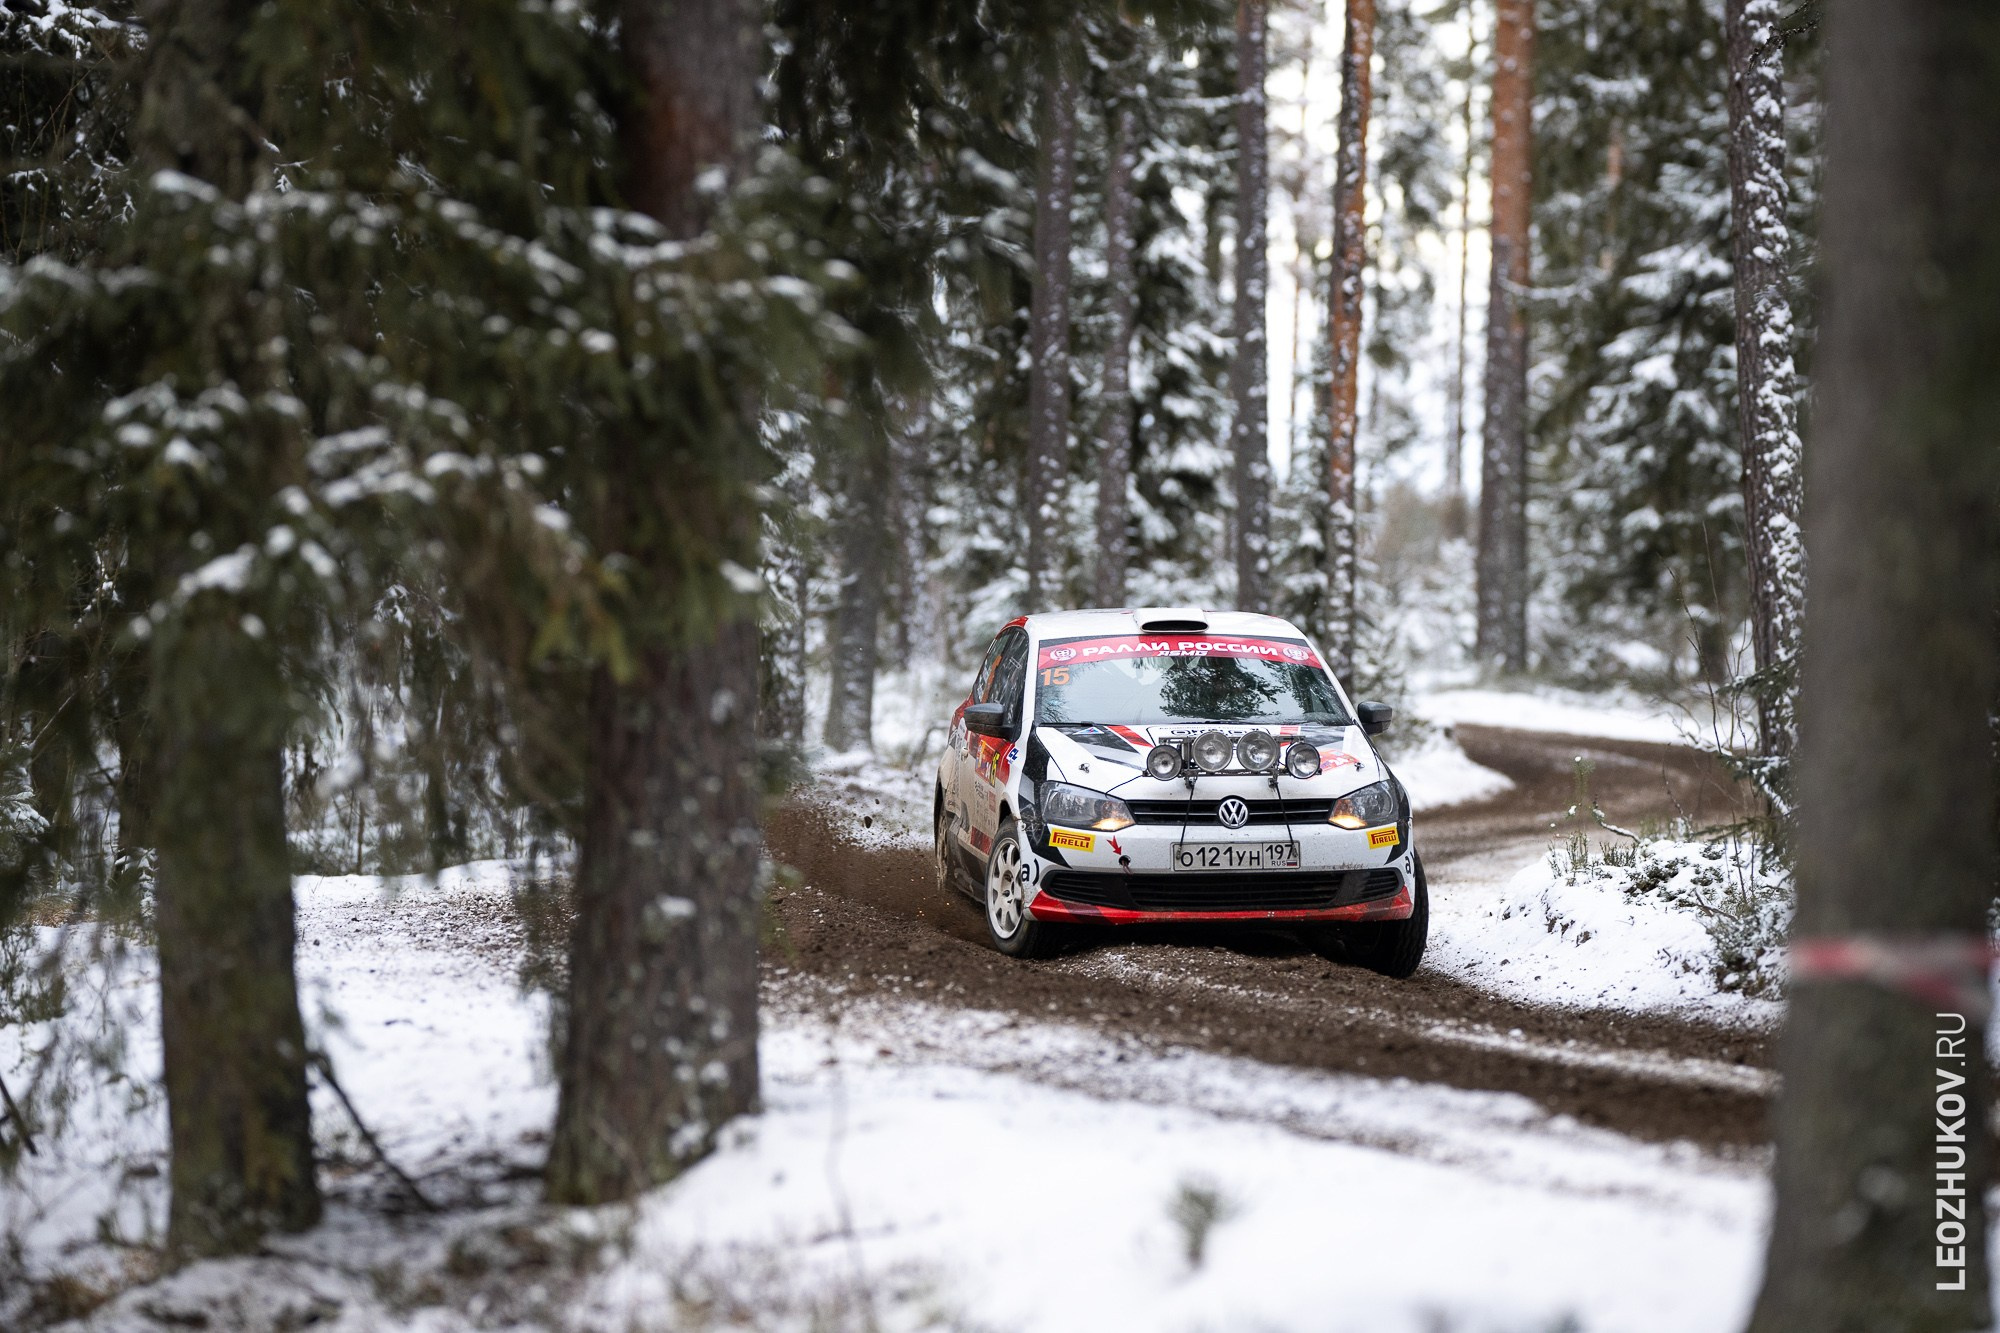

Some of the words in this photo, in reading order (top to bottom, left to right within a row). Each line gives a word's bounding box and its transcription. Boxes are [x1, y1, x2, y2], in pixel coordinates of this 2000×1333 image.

[1082, 641, 1170, 656] РАЛЛИ
[1178, 641, 1278, 656] РОССИИ
[1040, 667, 1070, 686] 15
[1052, 830, 1091, 849] PIRELLI
[1370, 829, 1397, 845] PIRELLI
[1265, 844, 1293, 860] 197
